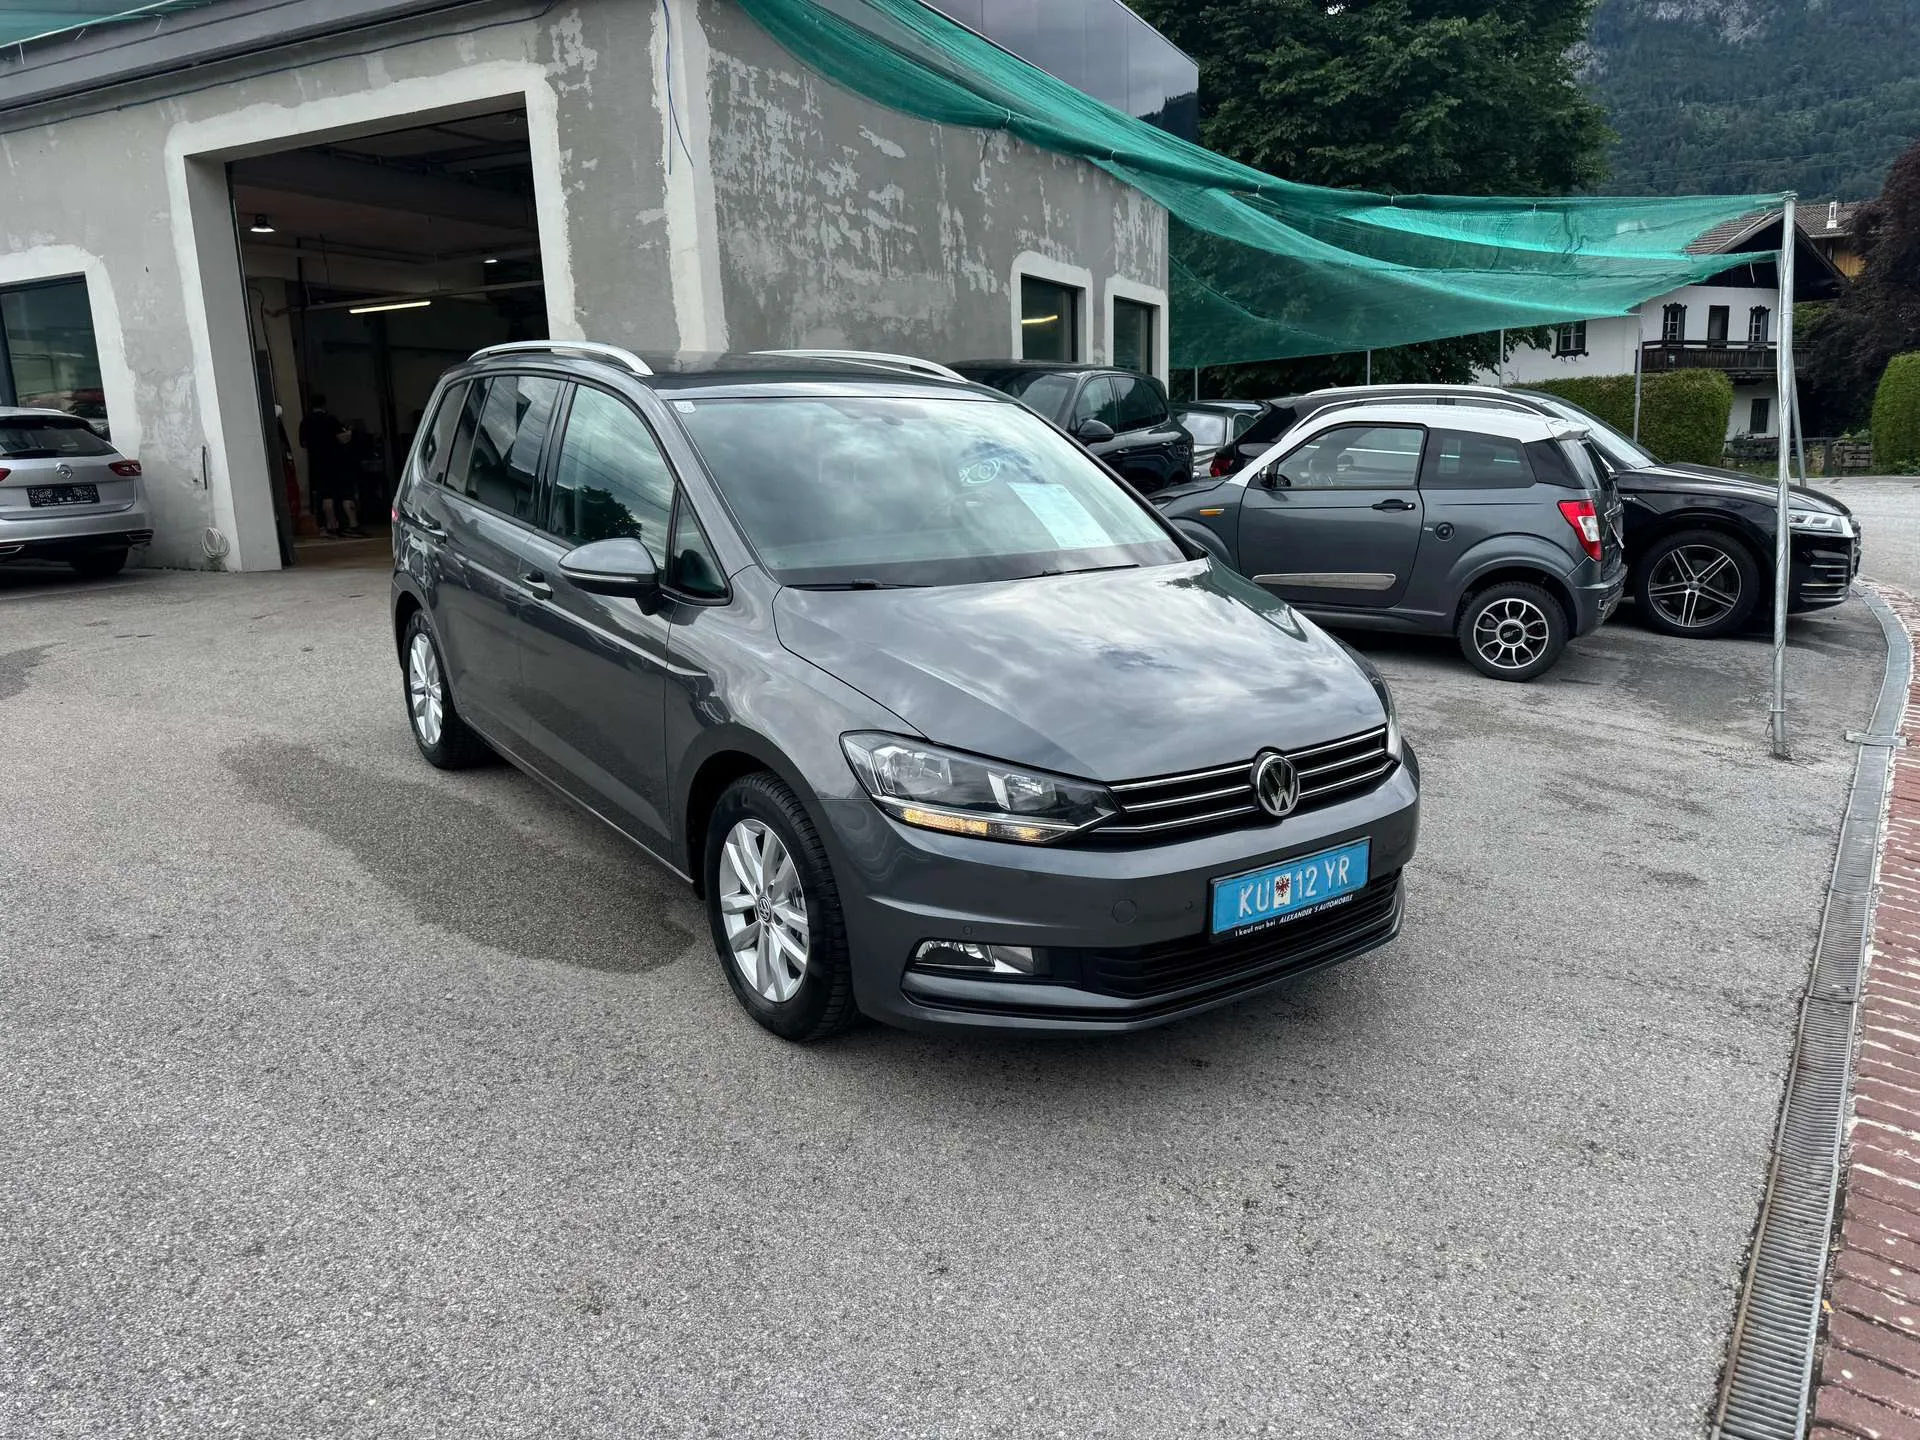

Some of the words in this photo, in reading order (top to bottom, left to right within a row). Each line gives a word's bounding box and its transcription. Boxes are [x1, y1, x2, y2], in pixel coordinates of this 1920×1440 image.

[1238, 879, 1270, 918] KU
[1296, 866, 1318, 899] 12
[1324, 855, 1350, 890] YR
[1318, 893, 1354, 912] AUTOMOBILE
